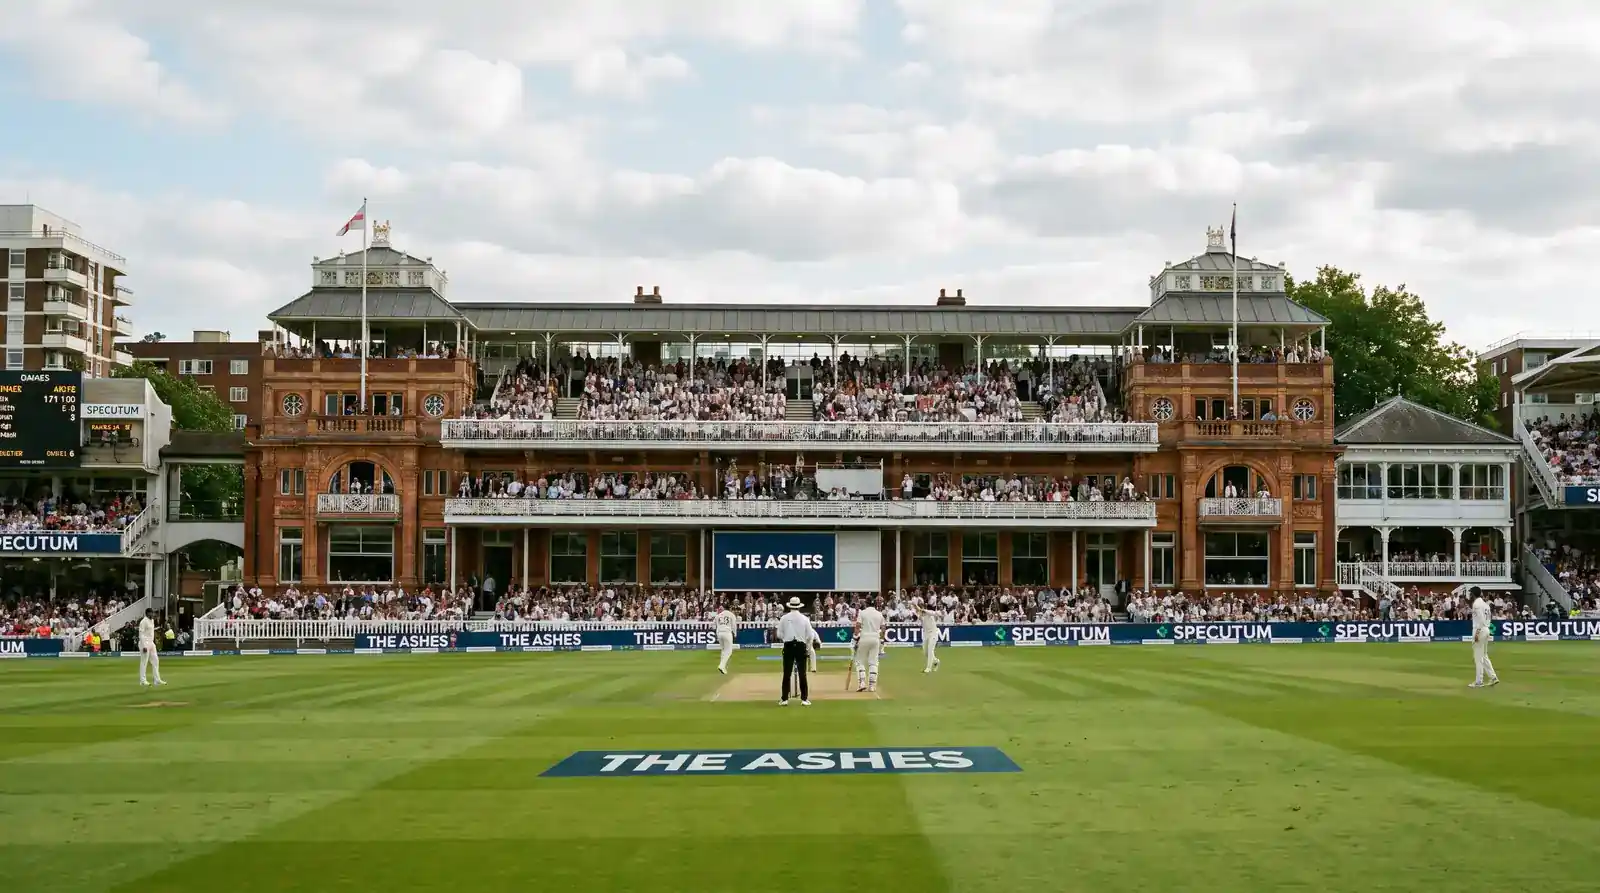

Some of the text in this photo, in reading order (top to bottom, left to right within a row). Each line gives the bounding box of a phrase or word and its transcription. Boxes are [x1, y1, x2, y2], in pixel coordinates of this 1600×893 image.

[43, 395, 76, 403] 171 100
[86, 405, 139, 415] SPECUTUM
[1587, 488, 1600, 502] S
[726, 554, 824, 569] THE ASHES
[1011, 626, 1110, 641] SPECUTUM
[1173, 625, 1272, 639] SPECUTUM
[1335, 623, 1435, 638] SPECUTUM
[1502, 621, 1600, 636] SPECUTUM
[366, 635, 449, 648] THE ASHES
[500, 633, 582, 646] THE ASHES
[634, 631, 716, 645] THE ASHES
[600, 750, 974, 772] THE ASHES
